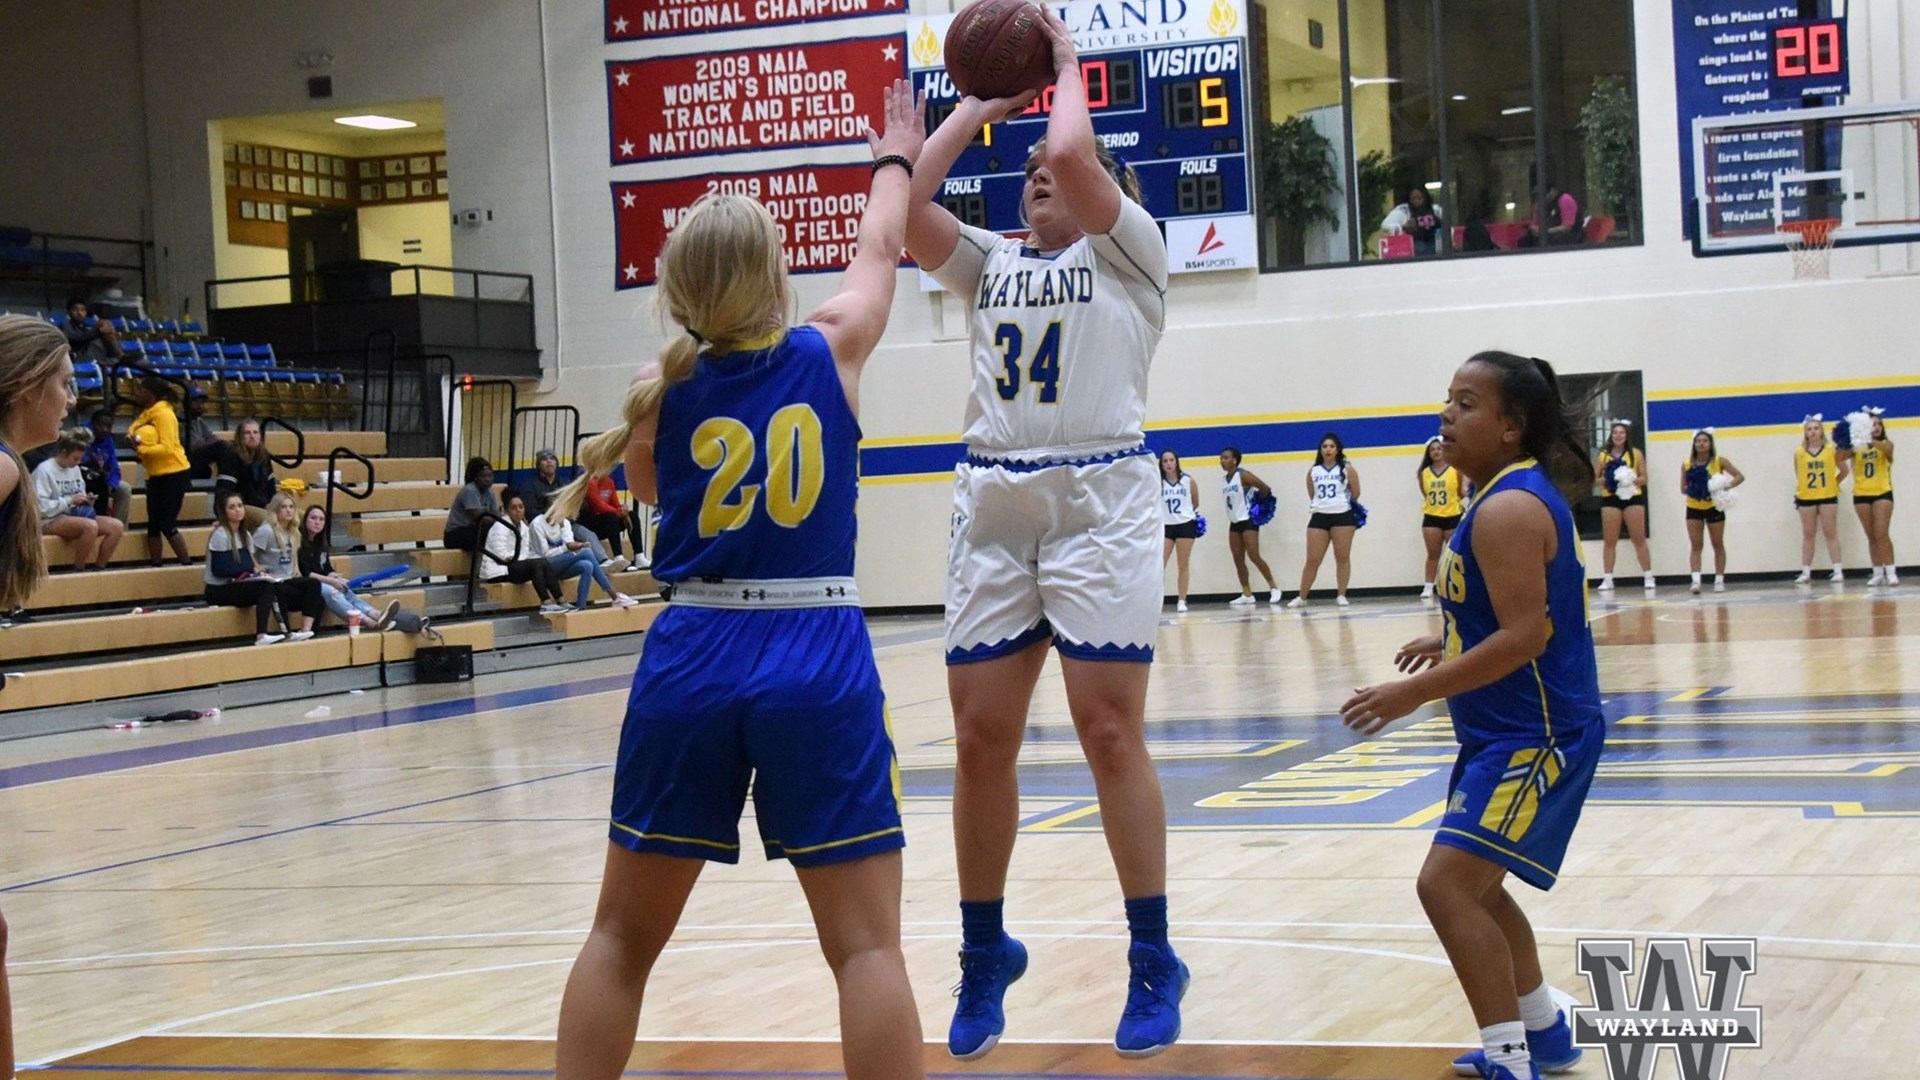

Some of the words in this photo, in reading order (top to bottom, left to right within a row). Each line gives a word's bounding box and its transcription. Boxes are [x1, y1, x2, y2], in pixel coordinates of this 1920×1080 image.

[643, 7, 746, 32] NATIONAL
[1058, 0, 1187, 33] LAND
[1694, 14, 1709, 26] On
[1711, 13, 1728, 25] the
[1730, 10, 1764, 23] Plains
[1767, 8, 1777, 19] of
[1072, 28, 1188, 49] NIVERSITY
[1713, 33, 1747, 45] where
[1749, 30, 1767, 42] the
[1147, 43, 1238, 78] VISITOR
[1698, 54, 1728, 67] sings
[1730, 51, 1753, 63] loud
[1775, 24, 1839, 77] 20
[696, 55, 750, 81] 2009
[758, 50, 808, 74] NAIA
[663, 76, 759, 107] WOMEN'S
[767, 69, 847, 97] INDOOR
[924, 71, 961, 99] HO
[1704, 72, 1749, 86] Gateway
[1751, 71, 1762, 82] to
[1200, 78, 1228, 127] 5
[1722, 88, 1769, 104] resplend
[662, 102, 733, 130] TRACK
[741, 98, 783, 122] AND
[790, 92, 855, 118] FIELD
[649, 125, 751, 154] NATIONAL
[759, 114, 870, 144] CHAMPION
[1180, 158, 1217, 176] FOULS
[1718, 152, 1740, 163] firm
[1743, 148, 1799, 161] foundation
[707, 178, 761, 198] 2009
[769, 172, 818, 197] NAIA
[944, 178, 982, 196] FOULS
[1741, 173, 1748, 181] a
[1750, 169, 1769, 181] sky
[766, 193, 868, 220] OUTDOOR
[1736, 192, 1754, 201] our
[1721, 209, 1768, 223] Wayland
[795, 217, 858, 243] FIELD
[784, 242, 857, 268] HAMPIO
[978, 266, 1094, 309] WAYLAND
[993, 317, 1065, 406] 34
[690, 403, 825, 538] 20
[1807, 471, 1826, 489] 21
[1317, 483, 1337, 499] 33
[1428, 490, 1448, 506] 33
[1165, 498, 1182, 514] 12
